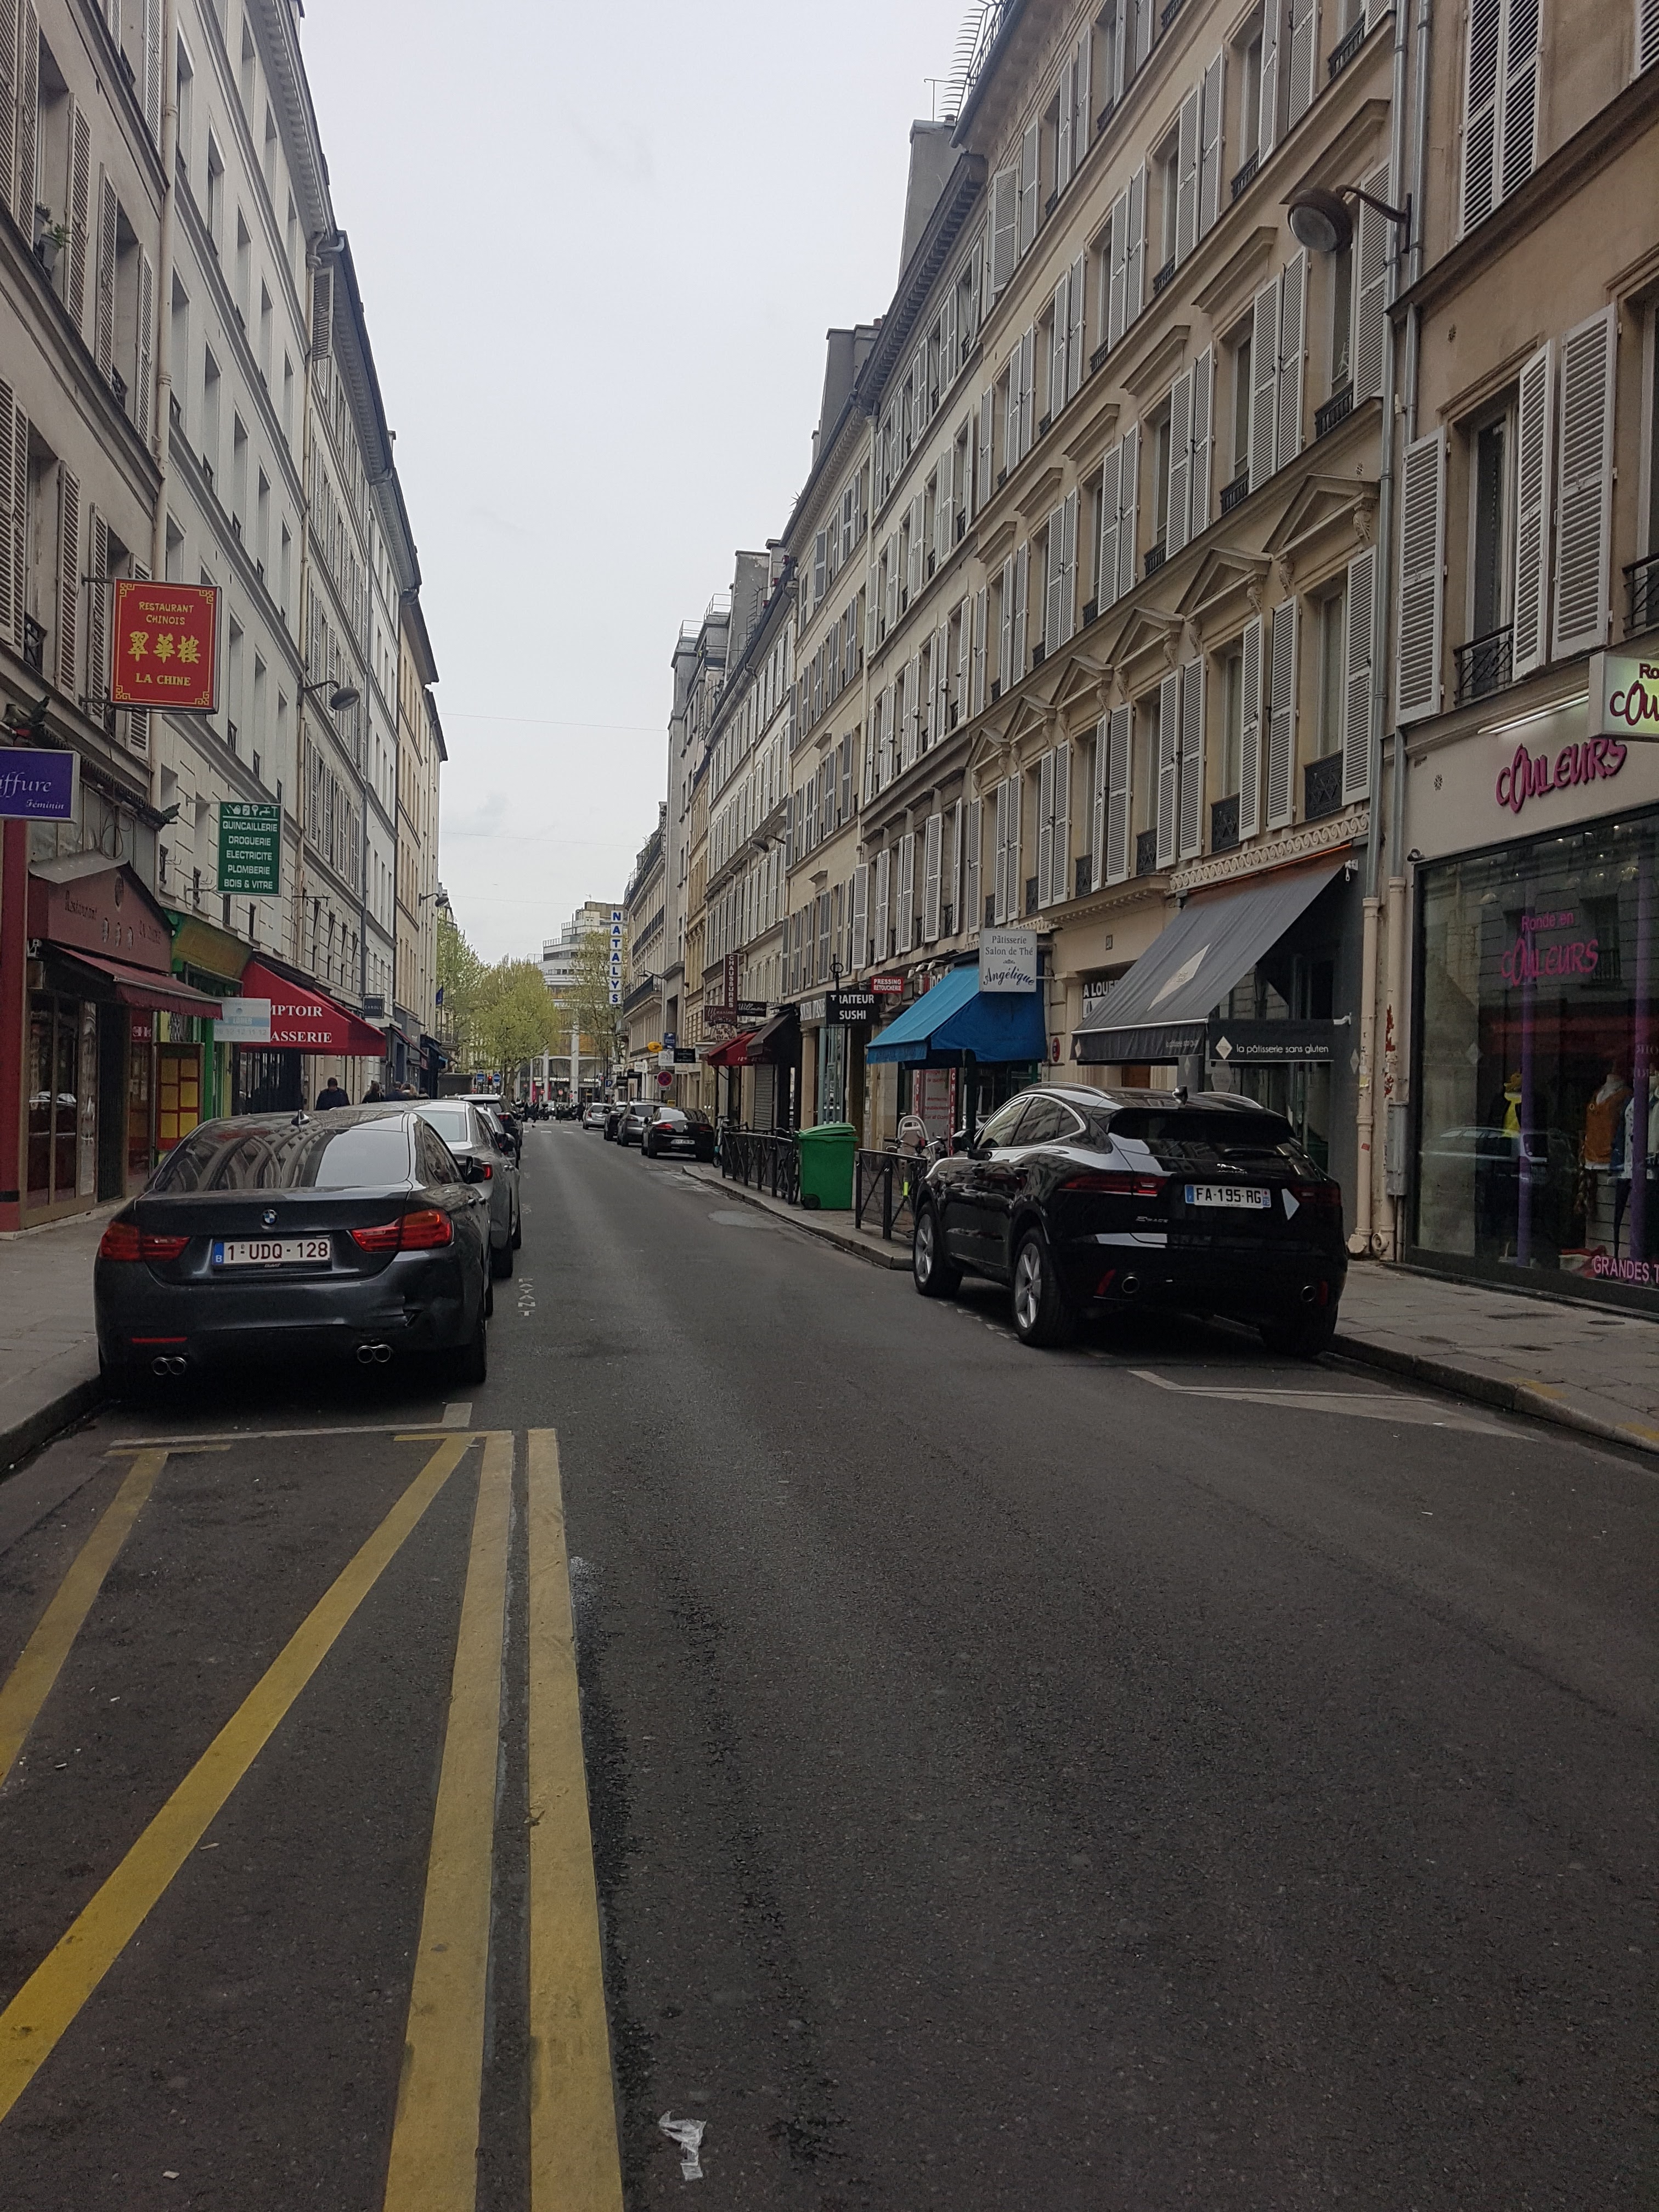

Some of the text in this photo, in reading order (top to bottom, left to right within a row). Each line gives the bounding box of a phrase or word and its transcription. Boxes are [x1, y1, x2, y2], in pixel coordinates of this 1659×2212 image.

[139, 601, 194, 613] RESTAURANT
[146, 614, 185, 625] CHINOIS
[127, 631, 201, 664] 翠華樓
[136, 673, 191, 686] LA CHINE
[223, 821, 278, 832] QUINCAILLERIE
[228, 836, 271, 846] DROGUERIE
[226, 850, 272, 860] ELECTRICITE
[228, 865, 270, 874] PLOMBERIE
[224, 879, 273, 889] BOIS & VITRE
[1522, 912, 1575, 932] Ronde en
[992, 935, 1027, 944] Pâtisserie
[985, 946, 1034, 956] Salon de Thé
[611, 912, 621, 1003] NATALYS
[983, 966, 1035, 986] Angélique
[1083, 984, 1090, 997] A
[839, 1010, 866, 1020] SUSHI
[270, 1030, 332, 1043] ASSERIE
[1237, 1043, 1244, 1053] la
[1246, 1044, 1283, 1056] pâtisserie
[1305, 1044, 1329, 1055] gluten
[1196, 1188, 1261, 1204] FA-195-RG
[1593, 1255, 1650, 1282] GRANDES
